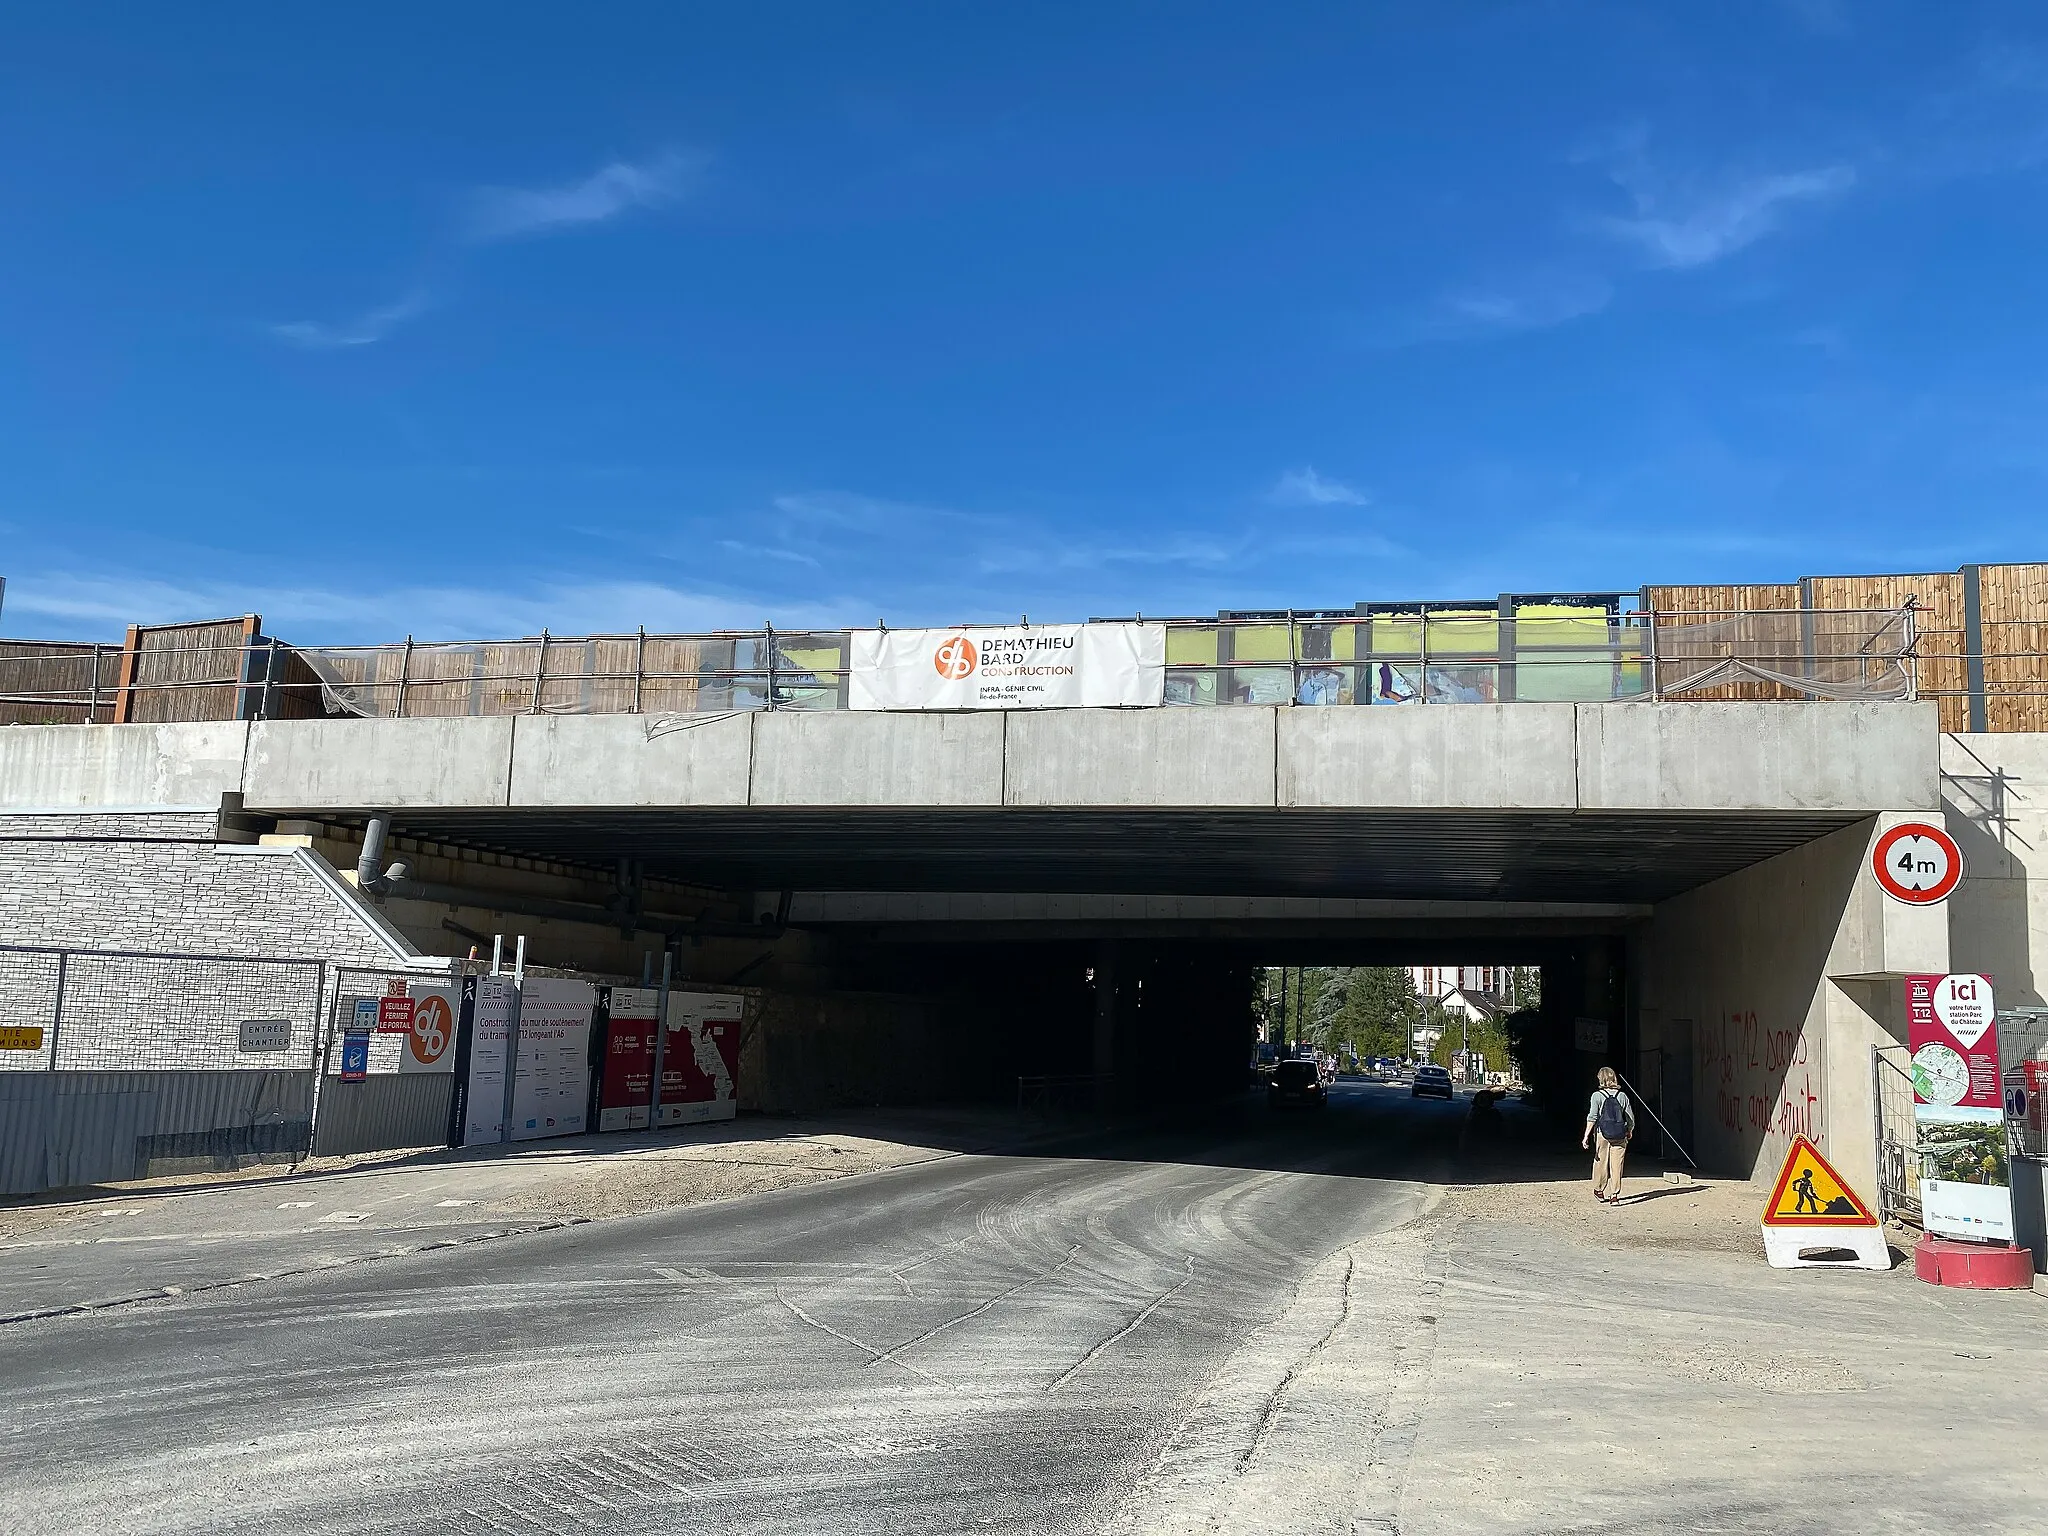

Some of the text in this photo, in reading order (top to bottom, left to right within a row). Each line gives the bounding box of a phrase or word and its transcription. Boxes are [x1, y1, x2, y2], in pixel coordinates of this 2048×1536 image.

[982, 637, 1074, 652] DEMATHIEU
[981, 653, 1024, 666] BARD
[981, 666, 1074, 677] CONSTRUCTION
[1898, 852, 1936, 873] 4 m
[1950, 980, 1977, 1000] ici
[385, 1012, 408, 1020] FERMER
[1912, 1008, 1931, 1018] T12
[380, 1021, 411, 1029] LE PORTAIL
[520, 1017, 528, 1027] du
[530, 1019, 541, 1027] mur
[541, 1017, 549, 1027] de
[248, 1024, 285, 1033] ENTRÉE
[480, 1031, 489, 1041] du
[490, 1030, 510, 1040] tramw
[528, 1028, 553, 1041] longeant
[242, 1038, 289, 1047] CHANTIER
[1766, 1022, 1808, 1071] sans
[1748, 1081, 1776, 1135] anti
